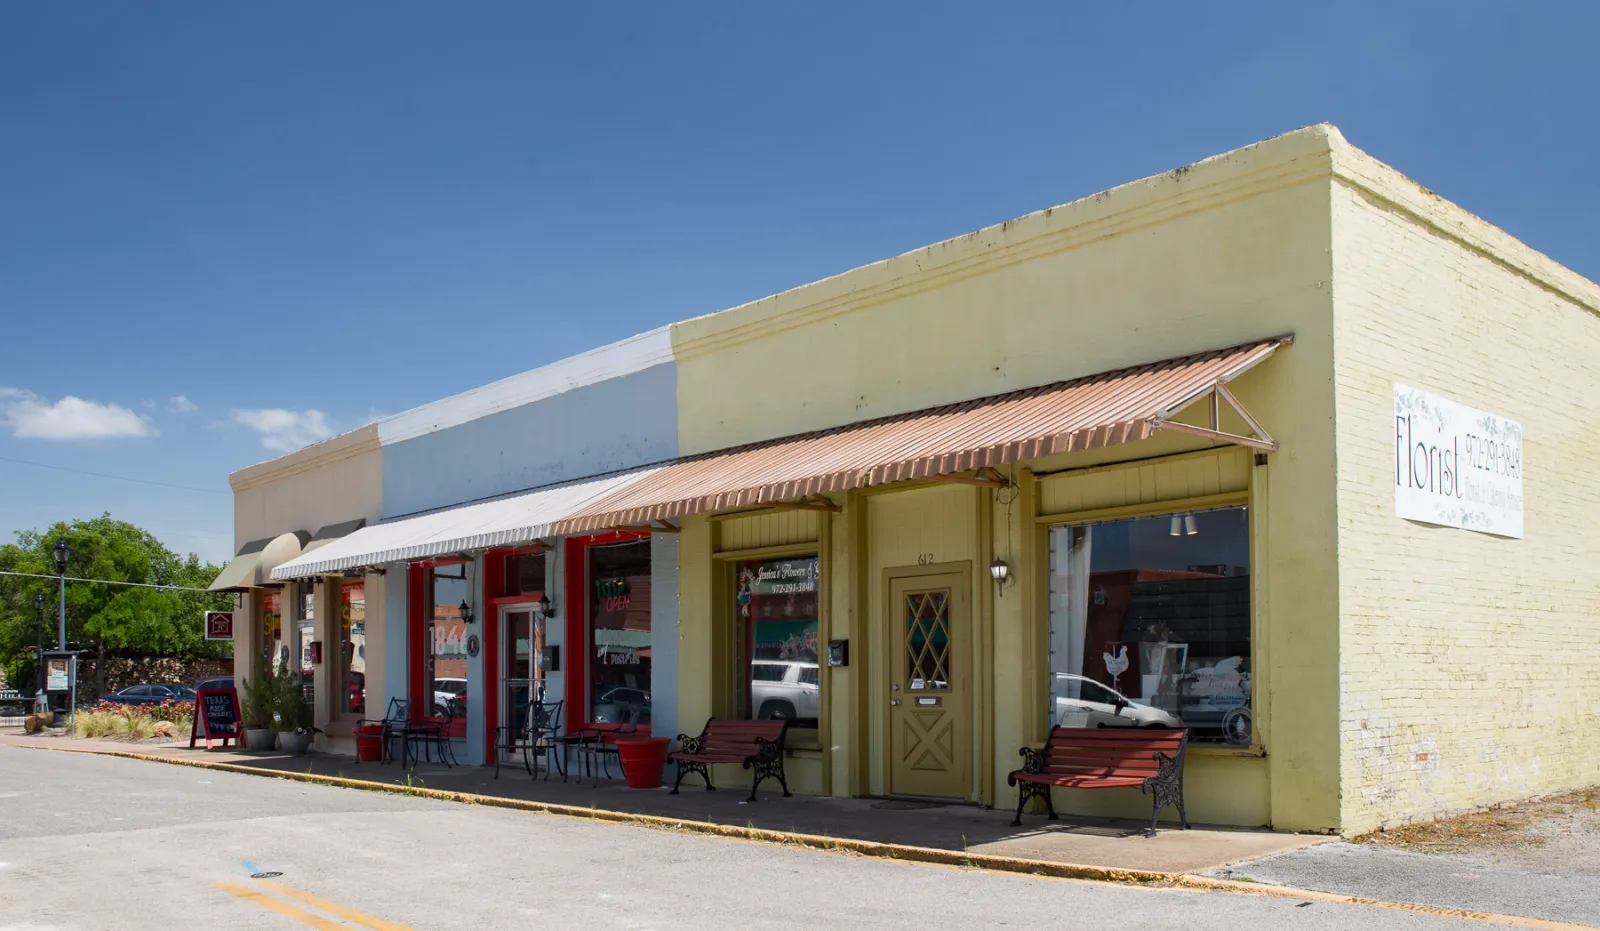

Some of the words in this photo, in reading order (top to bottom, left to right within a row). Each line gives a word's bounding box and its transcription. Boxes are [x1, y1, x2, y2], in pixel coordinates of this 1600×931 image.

[1396, 413, 1463, 499] Florist
[917, 553, 934, 566] 612
[756, 565, 781, 586] Jessica's
[782, 563, 806, 579] Flowers
[772, 582, 814, 594] 972-291-3848
[606, 595, 630, 612] OPEN
[204, 695, 230, 705] TEXAS
